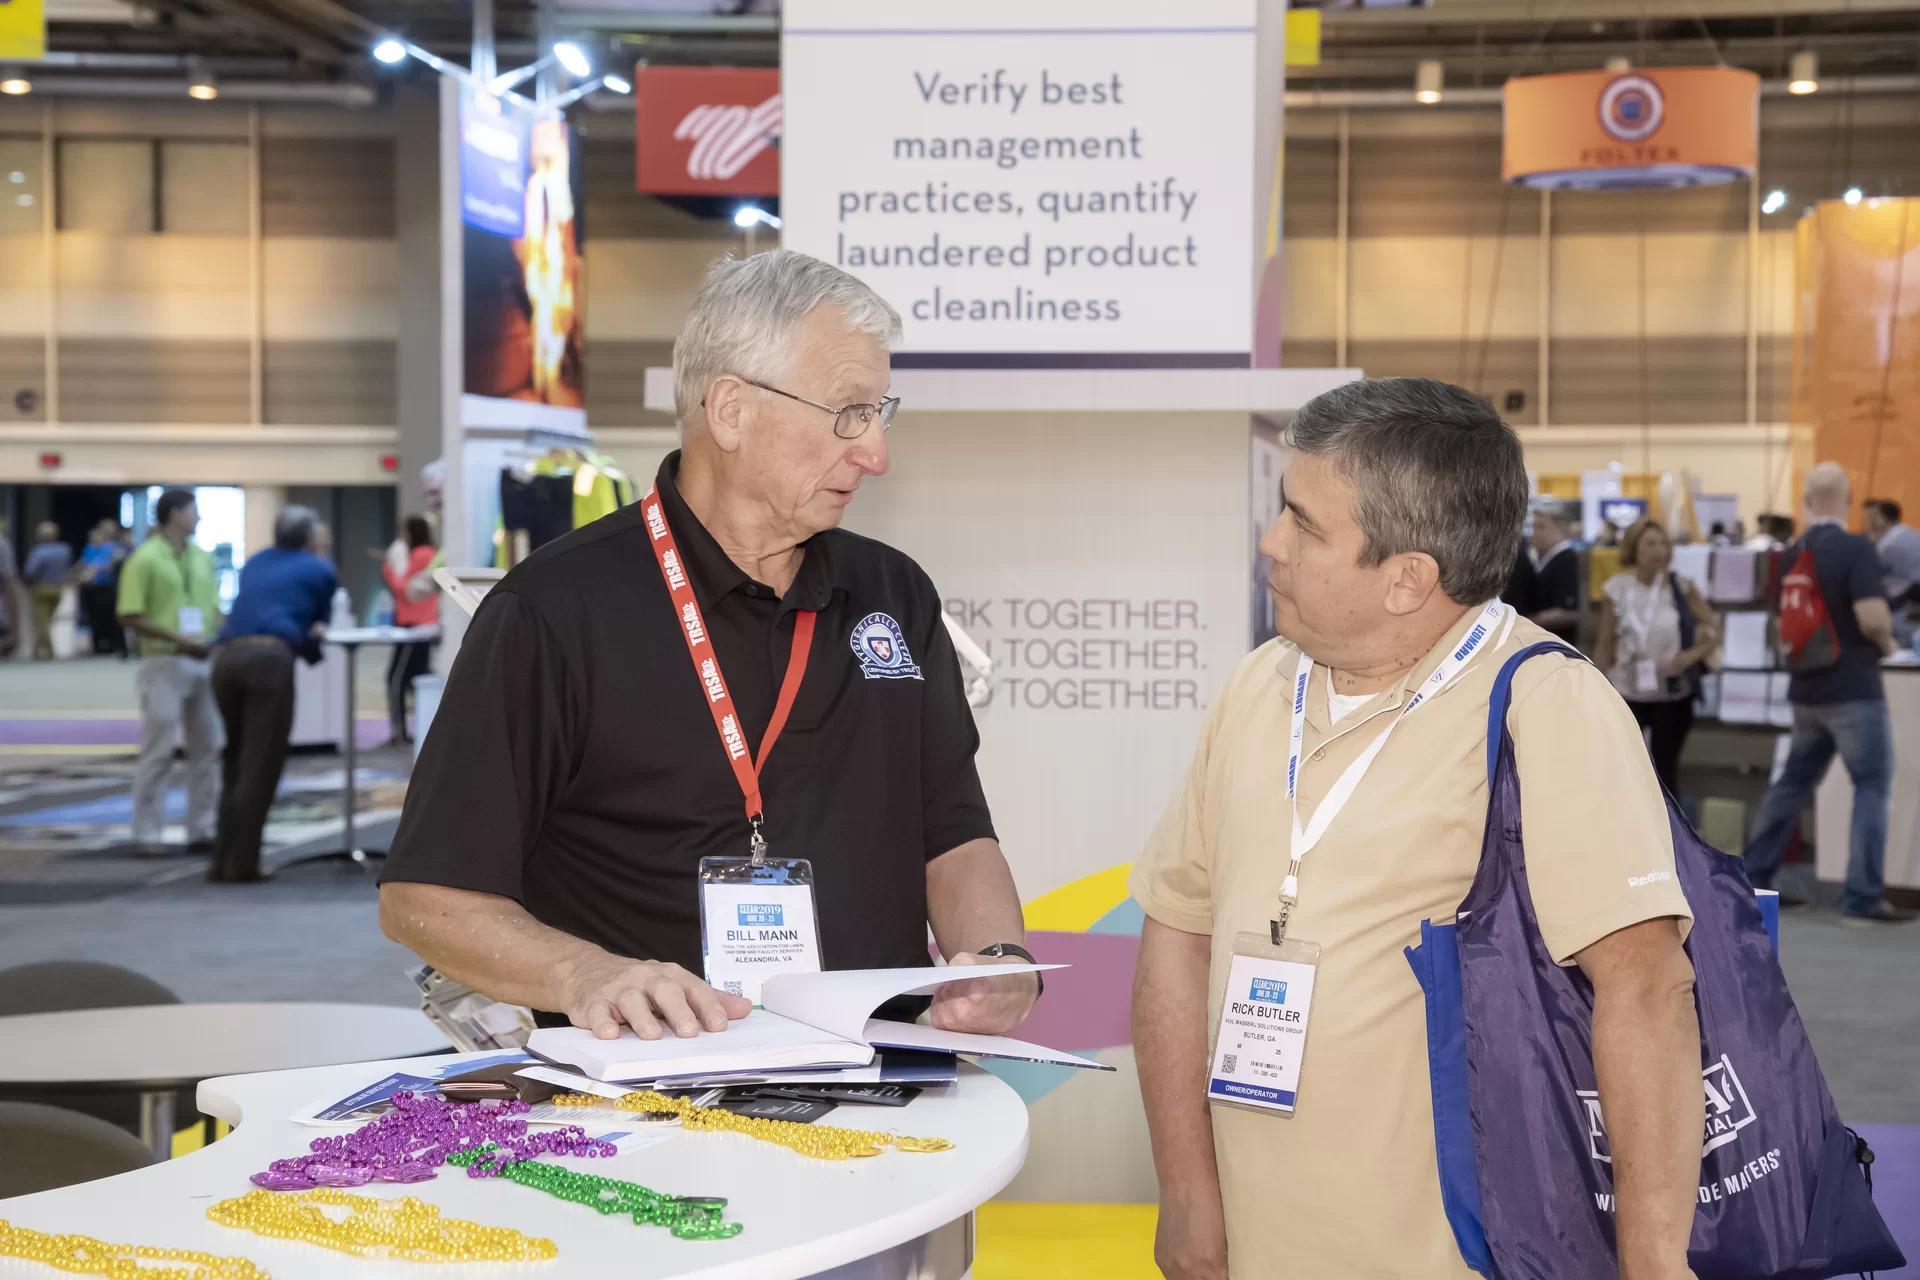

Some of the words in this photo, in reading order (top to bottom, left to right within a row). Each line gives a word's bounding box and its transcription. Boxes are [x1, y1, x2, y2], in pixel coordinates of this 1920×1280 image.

[914, 69, 1028, 114] Verify
[1041, 69, 1123, 105] best
[893, 127, 1142, 169] management
[838, 181, 1024, 222] practices,
[1037, 177, 1197, 222] quantify
[837, 233, 1030, 267] laundered
[1045, 233, 1198, 276] product
[911, 286, 1121, 321] cleanliness
[1003, 599, 1208, 630] TOGETHER.
[1003, 638, 1208, 670] TOGETHER.
[1454, 623, 1487, 661] LEONARD
[1003, 678, 1208, 710] TOGETHER.
[1295, 673, 1306, 714] LEONARD
[727, 930, 755, 941] BILL
[760, 930, 798, 940] MANN
[1231, 1002, 1255, 1016] RICK
[1257, 1006, 1301, 1023] BUTLER
[1257, 1023, 1285, 1032] SOLUTIONS
[1243, 1032, 1266, 1041] BUTLER,
[1225, 1084, 1278, 1099] OWNER/OPERATOR
